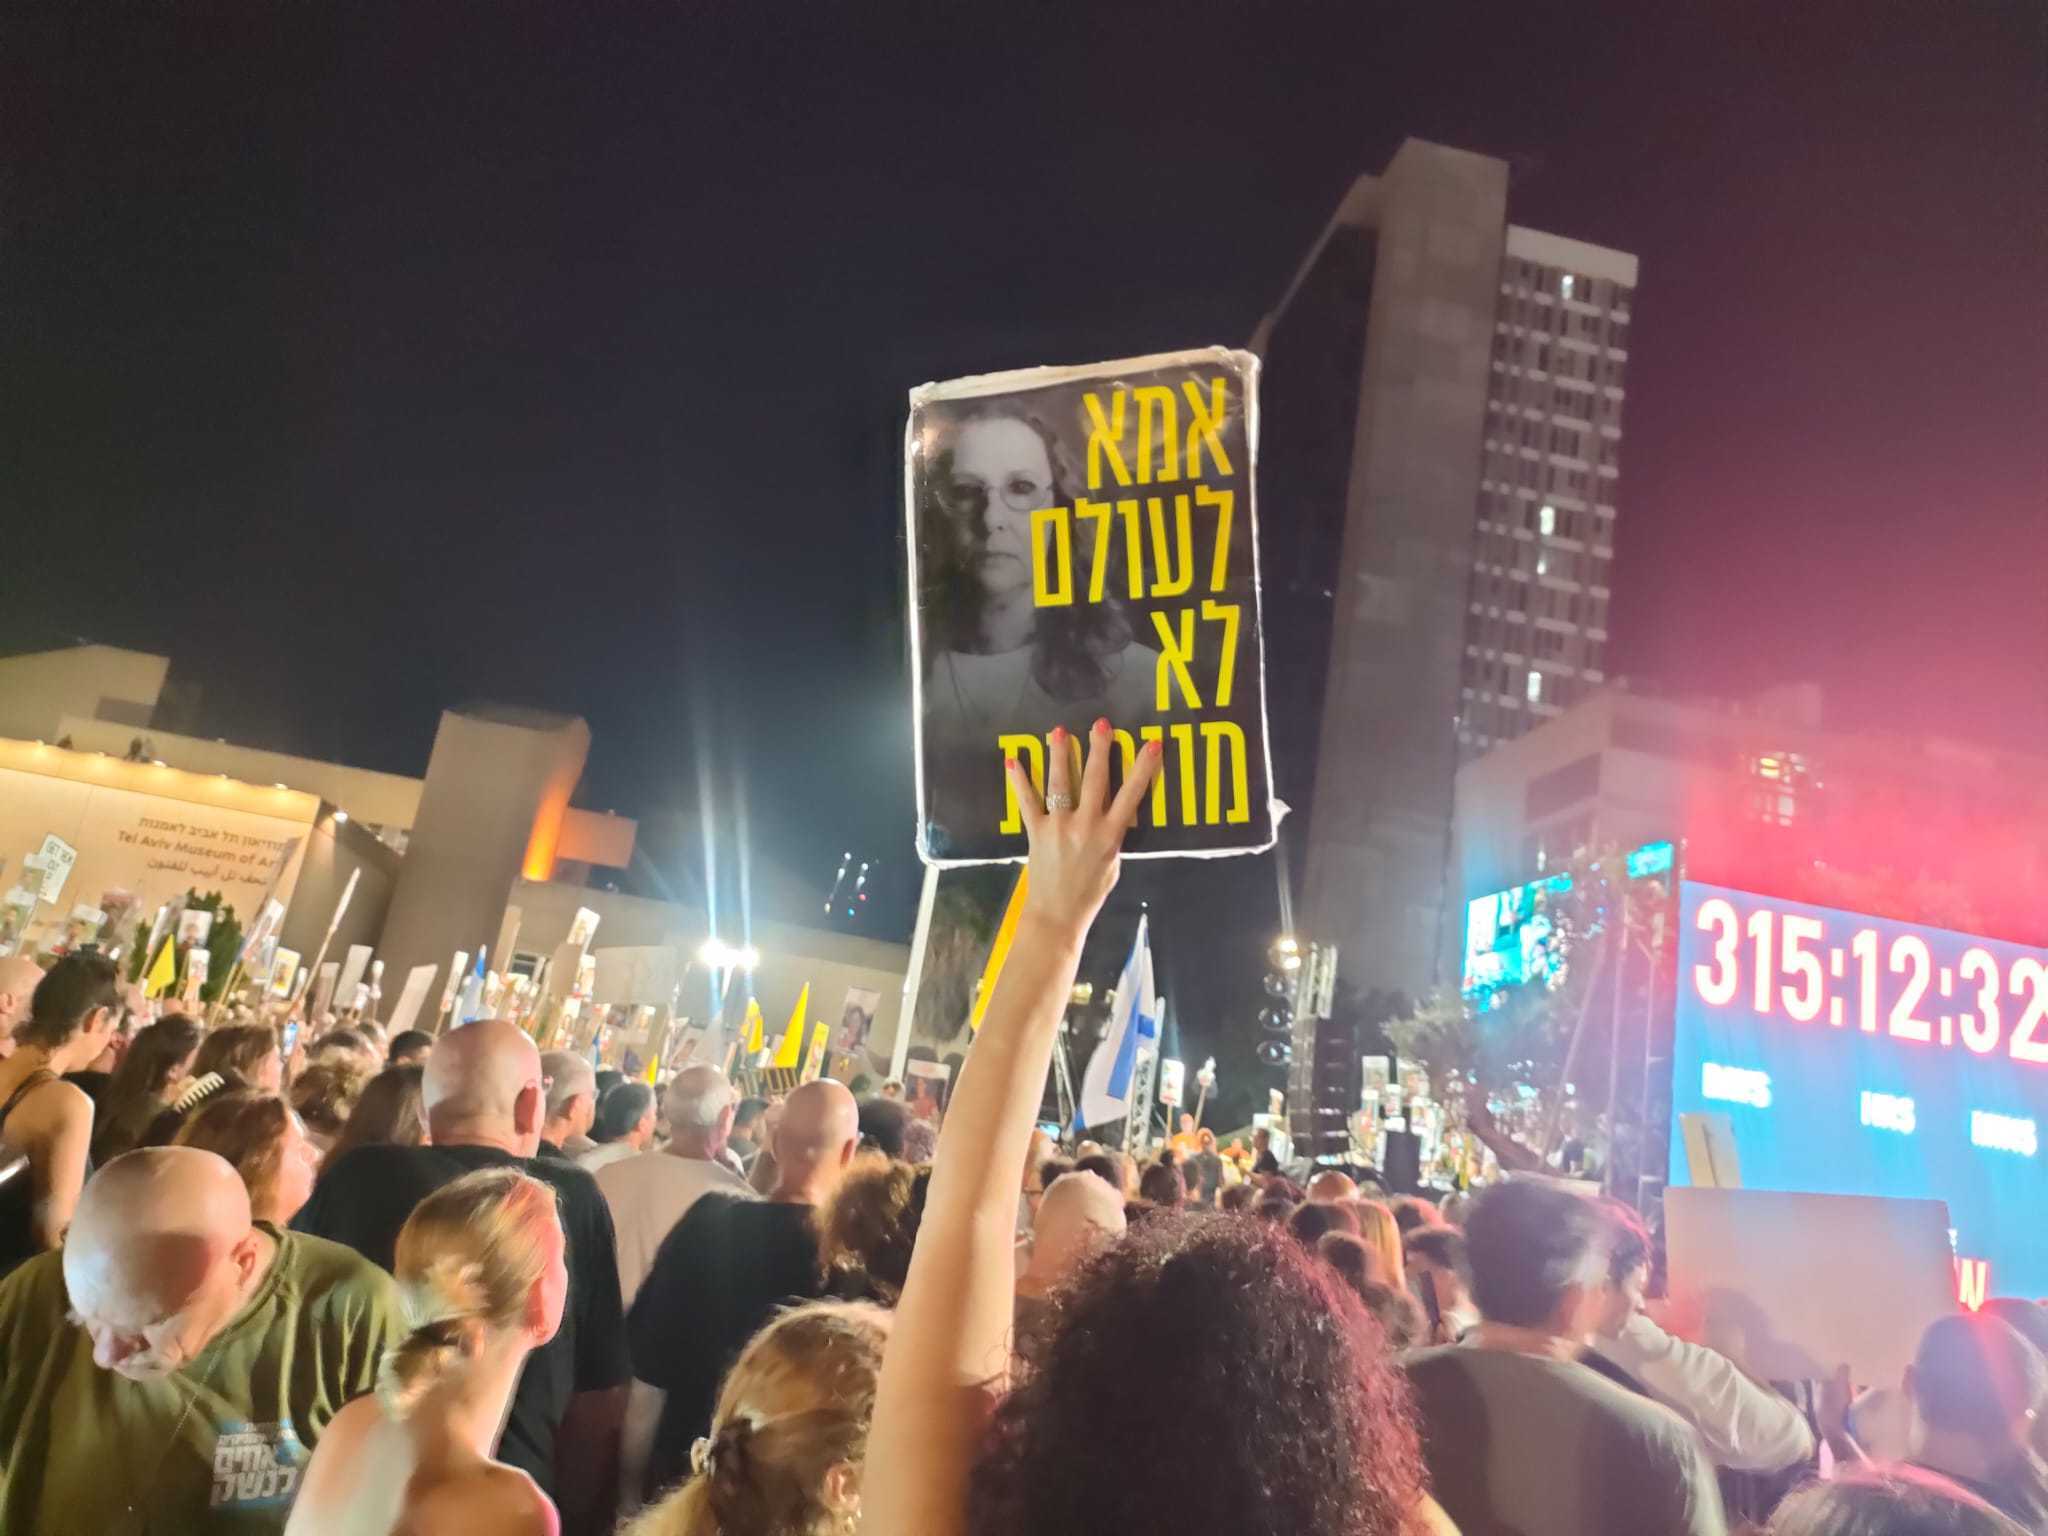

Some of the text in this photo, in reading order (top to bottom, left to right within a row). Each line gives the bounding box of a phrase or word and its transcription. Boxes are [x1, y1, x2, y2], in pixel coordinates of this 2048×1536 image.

[1083, 377, 1234, 490] אמא
[1030, 485, 1235, 608] לעולם
[1150, 599, 1240, 711] לא
[118, 830, 276, 868] Tel Aviv Museum of Ar
[210, 1466, 298, 1506] לנשק
